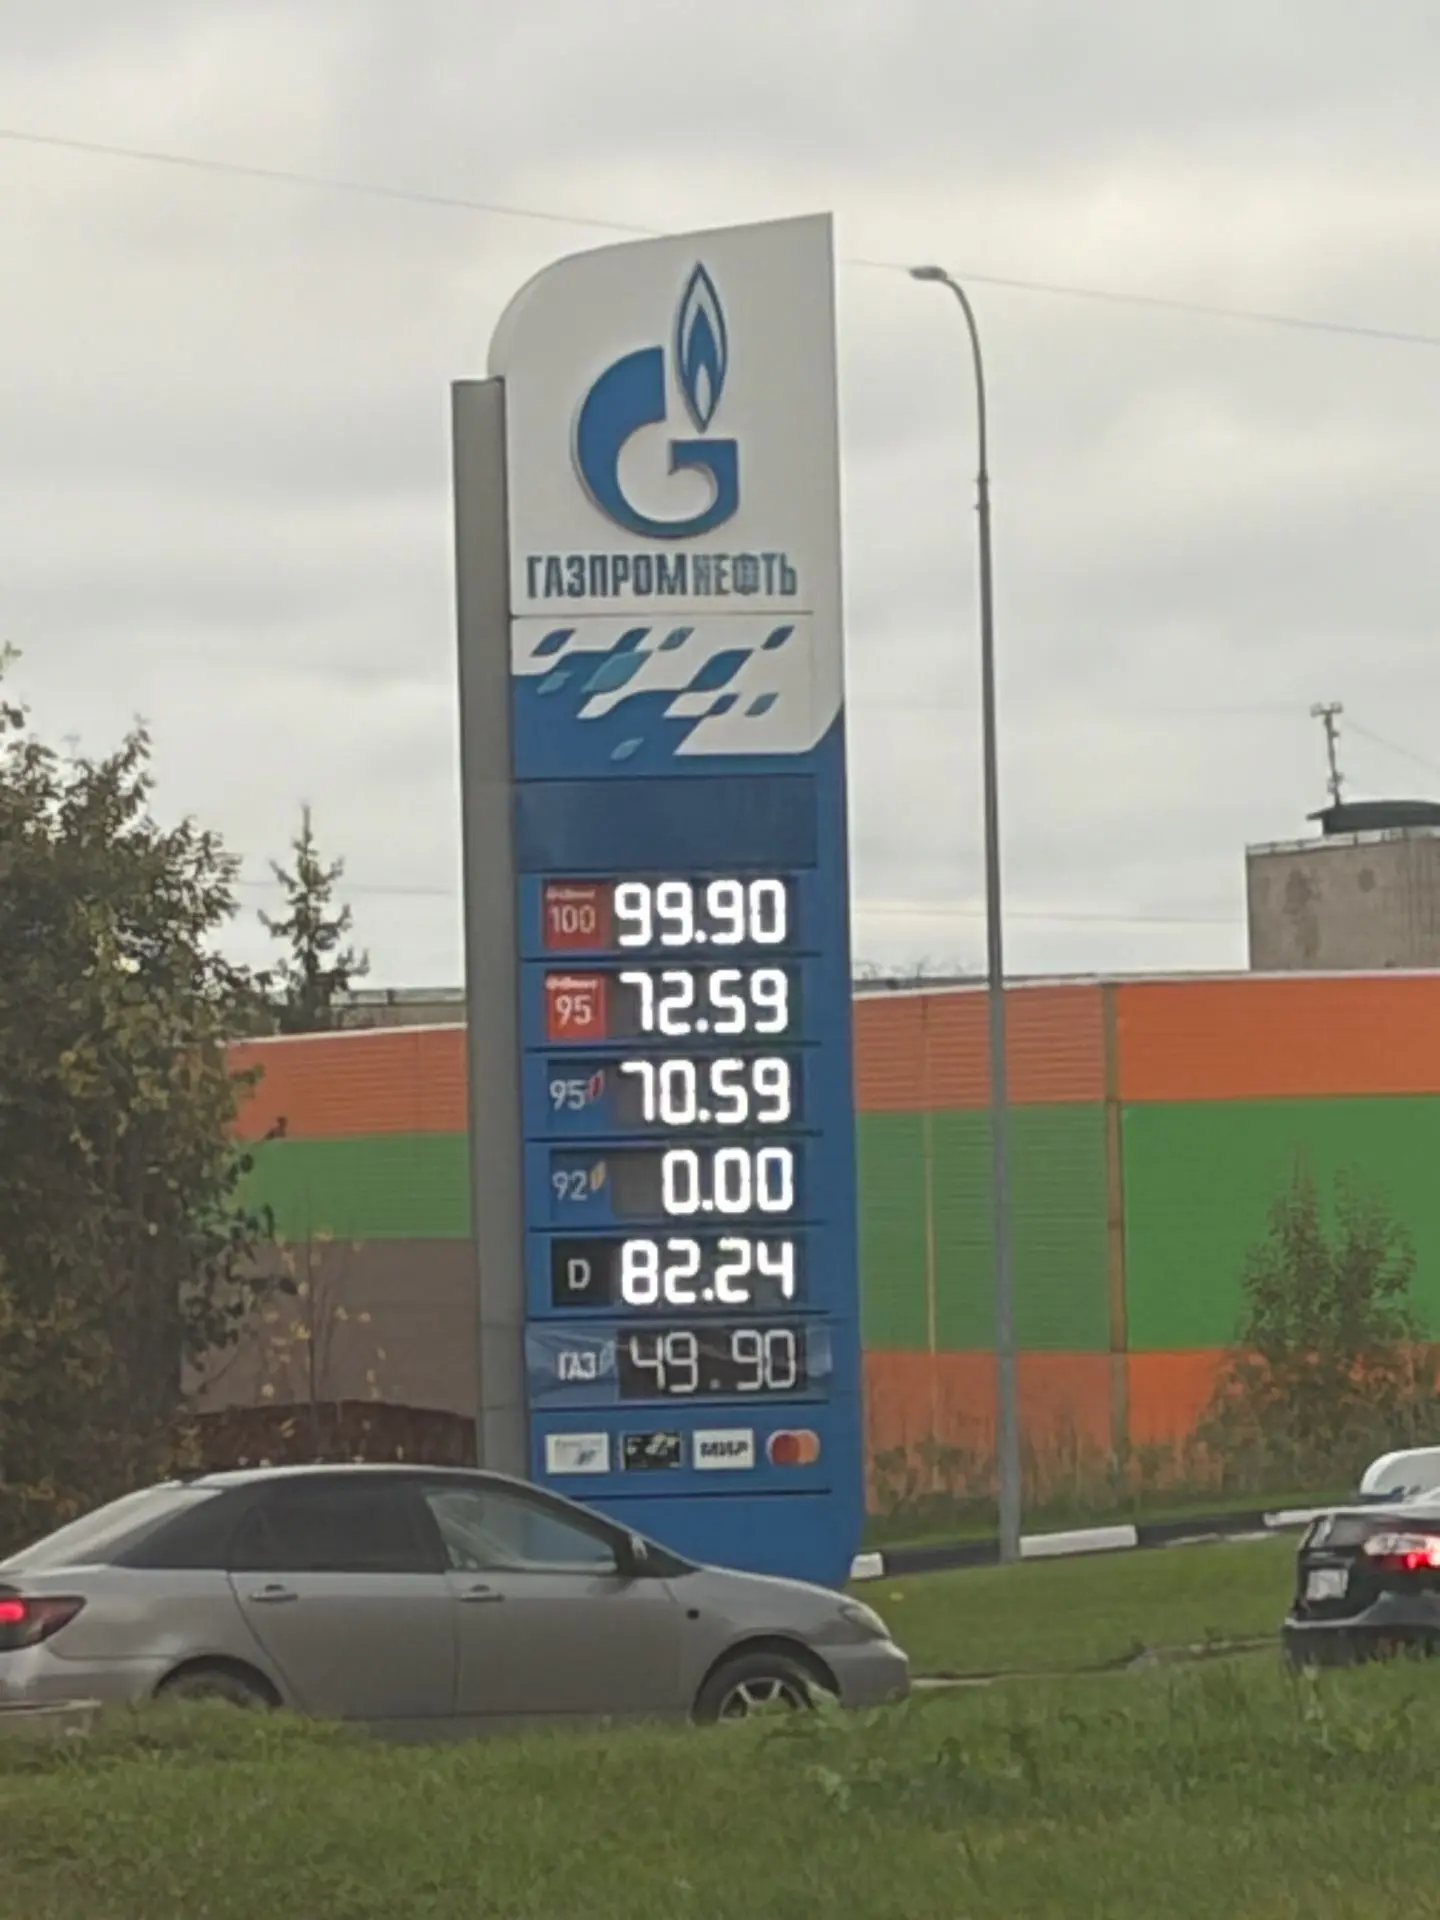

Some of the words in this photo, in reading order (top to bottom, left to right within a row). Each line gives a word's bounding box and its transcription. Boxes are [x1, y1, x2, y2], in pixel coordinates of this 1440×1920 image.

[526, 552, 797, 599] ГАЗПРОМНЕФТЬ
[551, 904, 596, 933] 100
[614, 879, 786, 946] 99.90
[555, 994, 592, 1028] 95
[619, 968, 788, 1035] 72.59
[549, 1079, 586, 1110] 95
[620, 1057, 791, 1124] 70.59
[552, 1171, 588, 1201] 92
[661, 1147, 793, 1214] 0.00
[567, 1258, 590, 1289] D
[621, 1237, 794, 1305] 82.24
[558, 1351, 596, 1380] ГАЗ
[630, 1329, 796, 1392] 49.90
